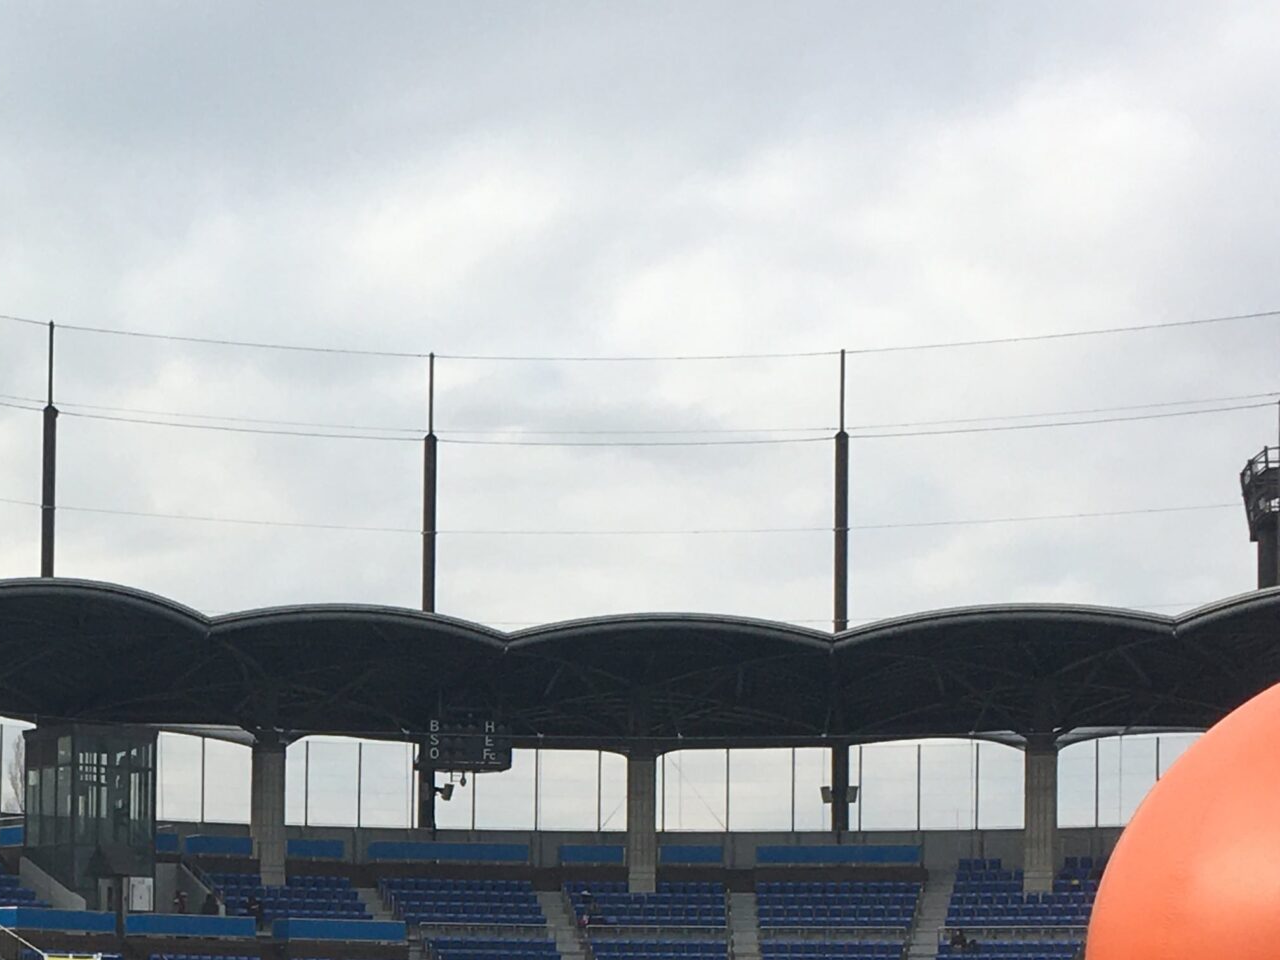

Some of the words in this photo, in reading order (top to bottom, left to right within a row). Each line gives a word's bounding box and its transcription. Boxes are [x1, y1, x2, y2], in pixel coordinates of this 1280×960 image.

[429, 719, 440, 732] B
[485, 721, 495, 733] H
[430, 734, 439, 746] S
